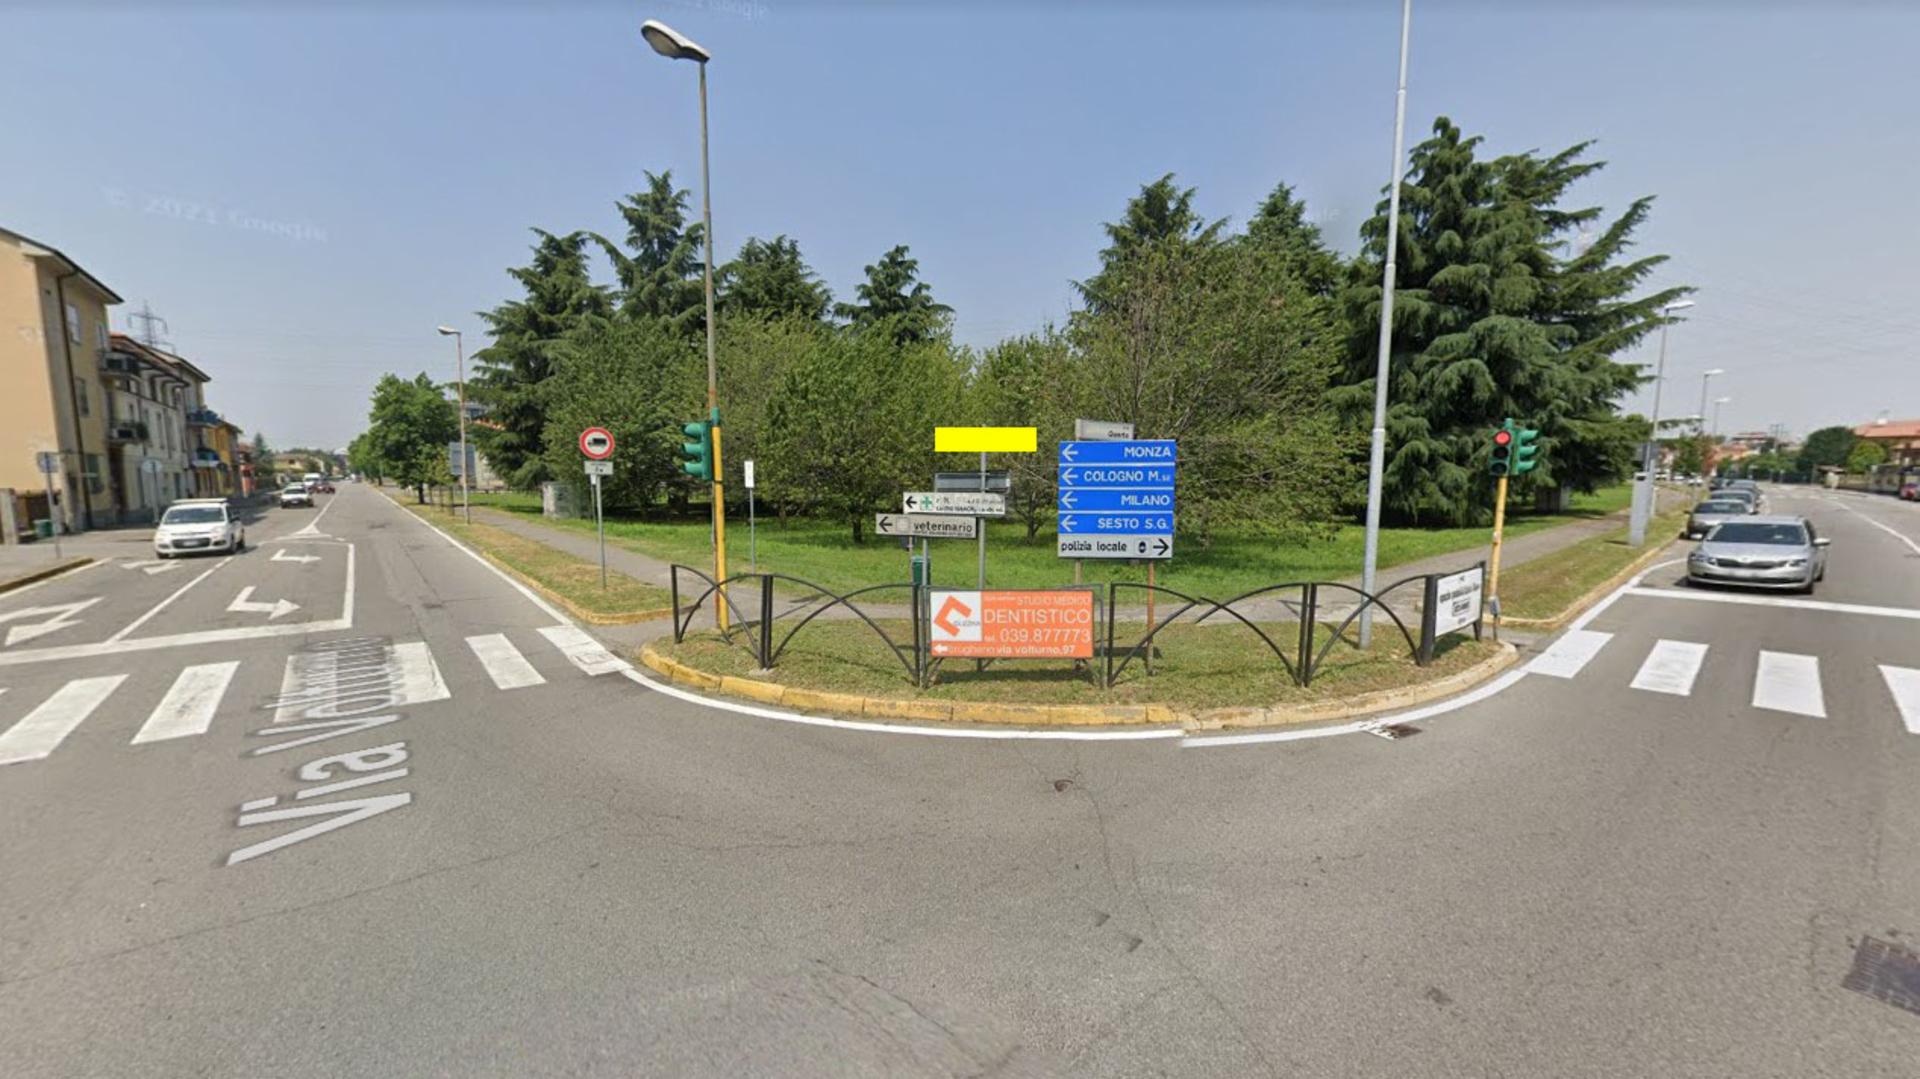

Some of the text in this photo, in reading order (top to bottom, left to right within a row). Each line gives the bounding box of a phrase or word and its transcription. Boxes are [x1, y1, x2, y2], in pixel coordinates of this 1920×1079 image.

[1124, 446, 1171, 458] MONZA
[1084, 470, 1143, 482] COLOGNO
[1121, 494, 1170, 506] MILANO
[913, 521, 973, 533] veterinario
[1098, 518, 1169, 529] SESTO S.G.
[1061, 541, 1127, 552] polizia locale
[1017, 596, 1053, 606] STUDIO
[984, 608, 1090, 624] DENTISTICO
[1001, 627, 1091, 643] 039.877773
[997, 645, 1012, 654] via
